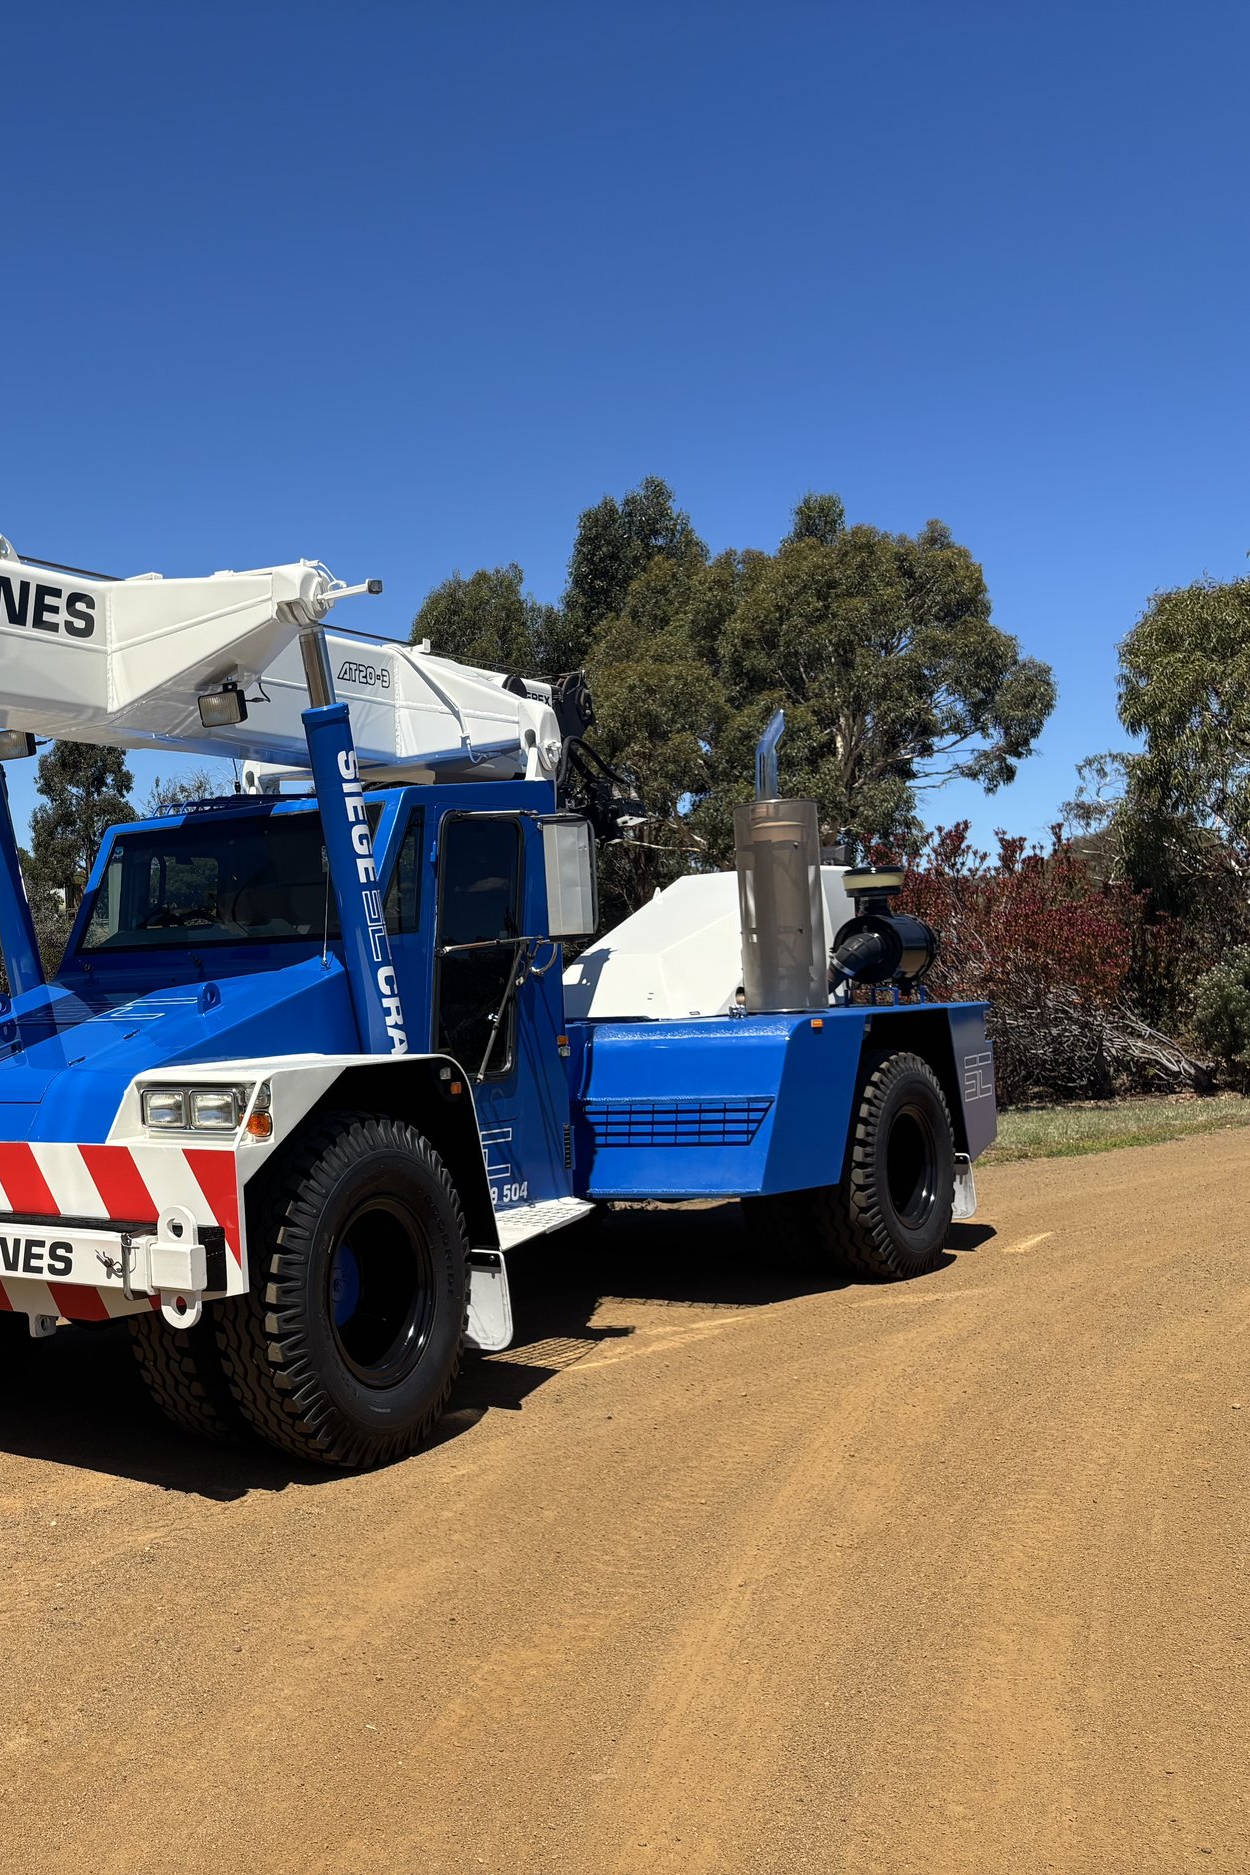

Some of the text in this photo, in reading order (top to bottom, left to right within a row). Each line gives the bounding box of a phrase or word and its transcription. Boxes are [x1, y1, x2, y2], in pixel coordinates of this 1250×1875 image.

[337, 661, 391, 689] AT20-3
[337, 750, 377, 884] SIEGE
[377, 965, 409, 1055] CRA
[503, 1181, 528, 1203] 504
